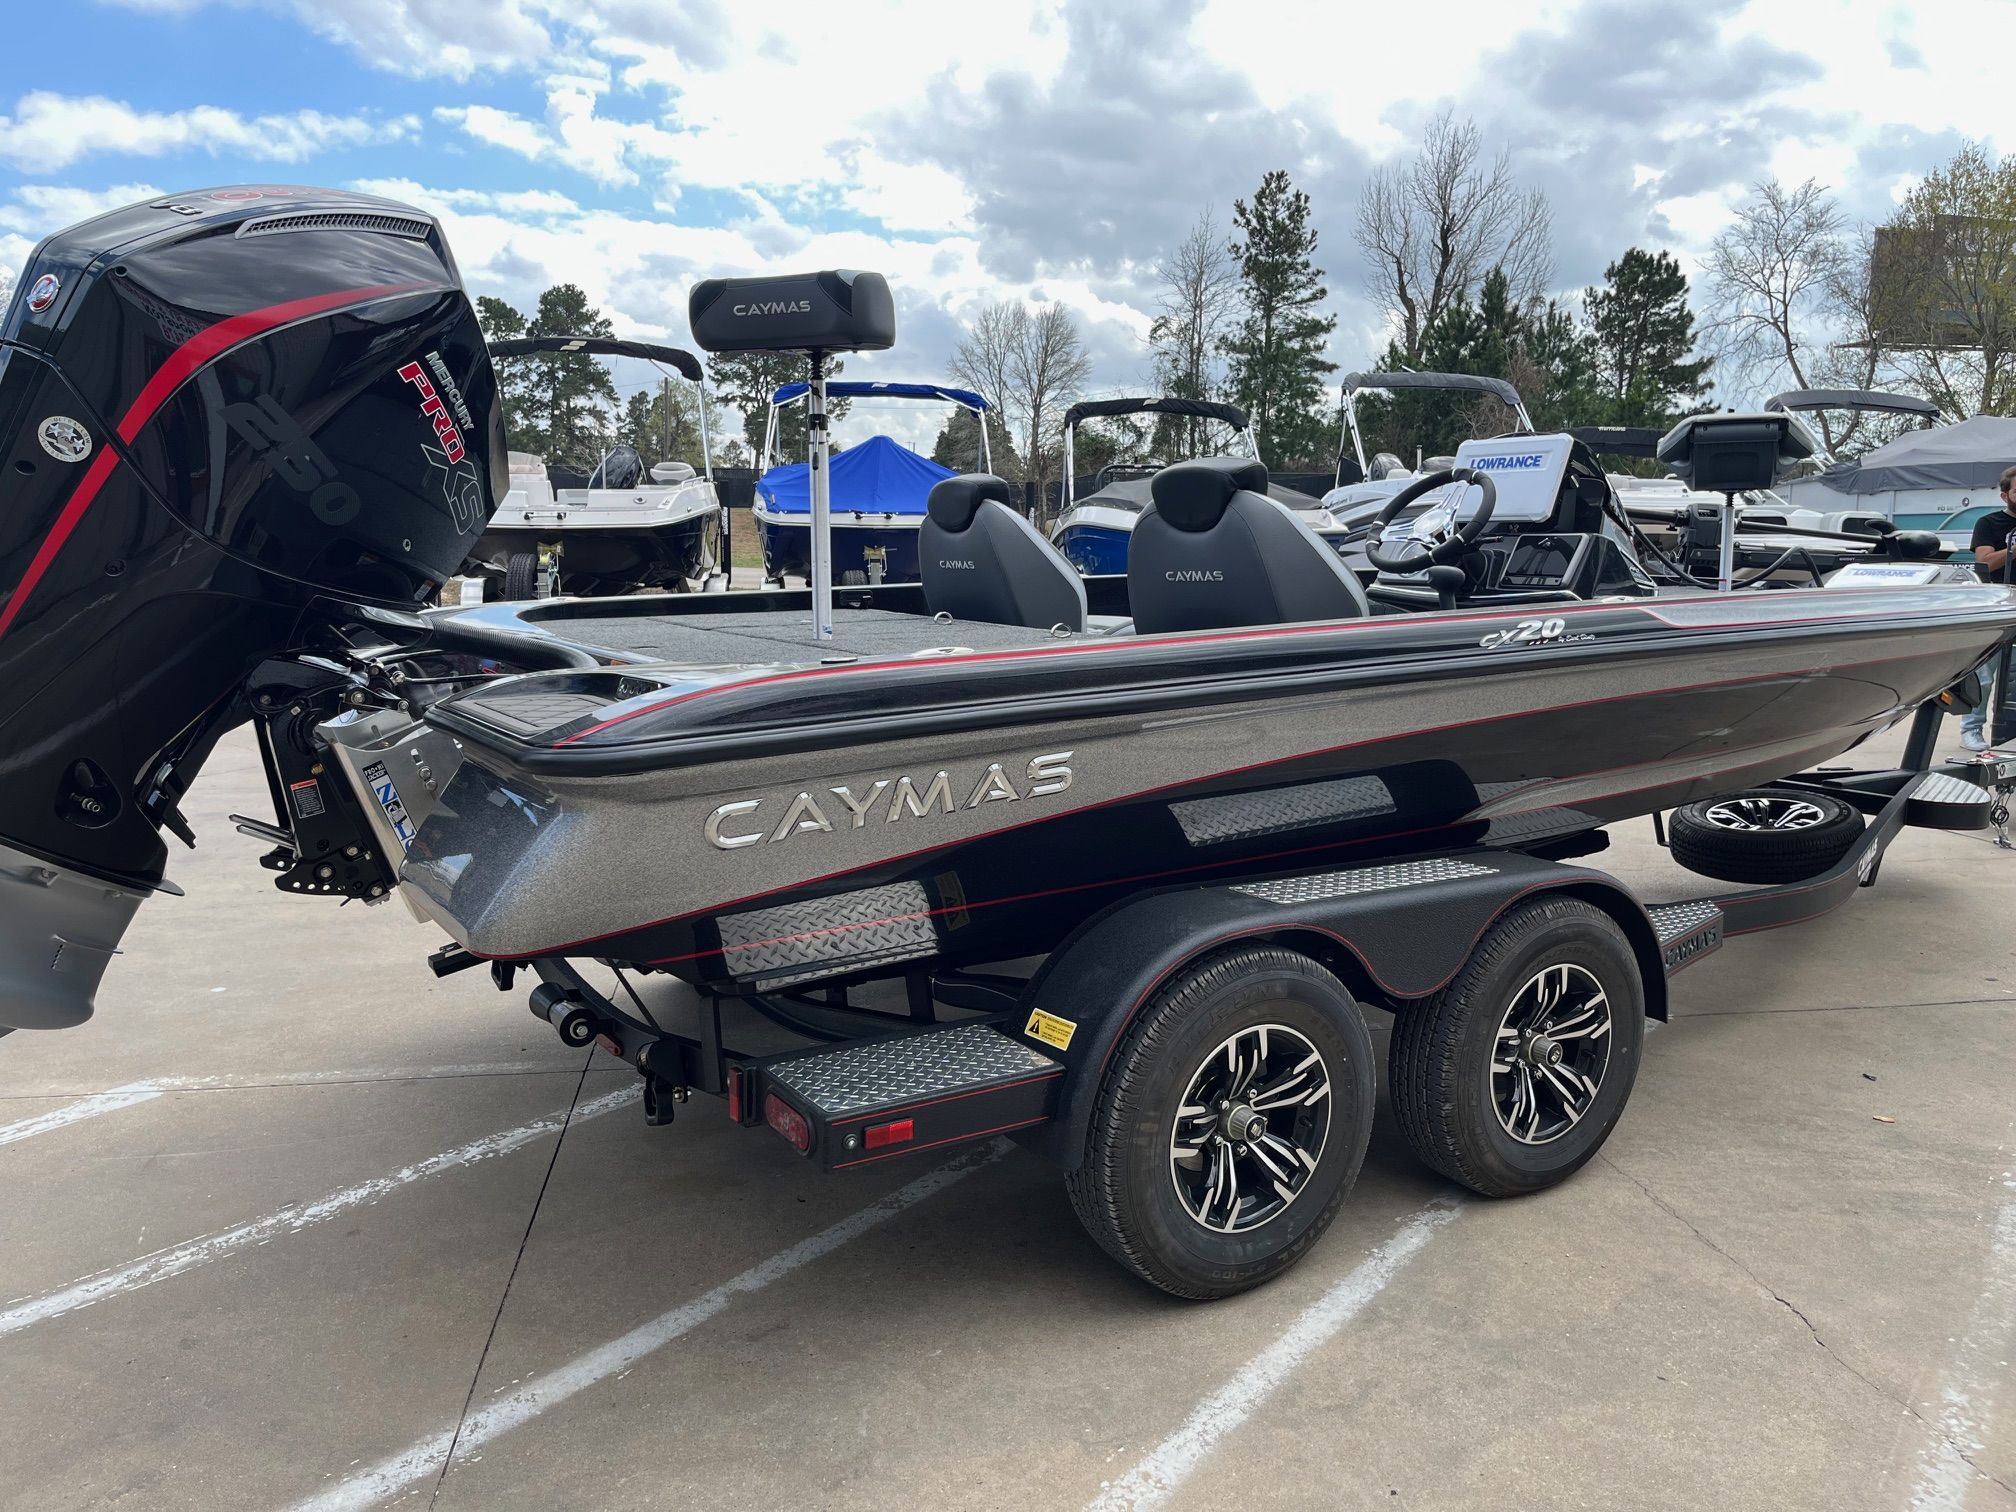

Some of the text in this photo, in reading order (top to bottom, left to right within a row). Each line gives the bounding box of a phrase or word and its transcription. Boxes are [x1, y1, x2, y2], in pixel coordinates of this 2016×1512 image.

[733, 300, 811, 316] CAYMAS
[425, 350, 475, 431] MERCURY
[216, 393, 361, 526] 250
[397, 360, 485, 536] PRO XS
[1470, 455, 1543, 470] LOWRANCE
[939, 560, 975, 570] CAYMAS
[1165, 570, 1224, 582] CAYMAS
[1853, 568, 1917, 578] LOWRANCE
[704, 751, 1074, 850] CAYMAS
[1664, 926, 1718, 968] CAYMAS
